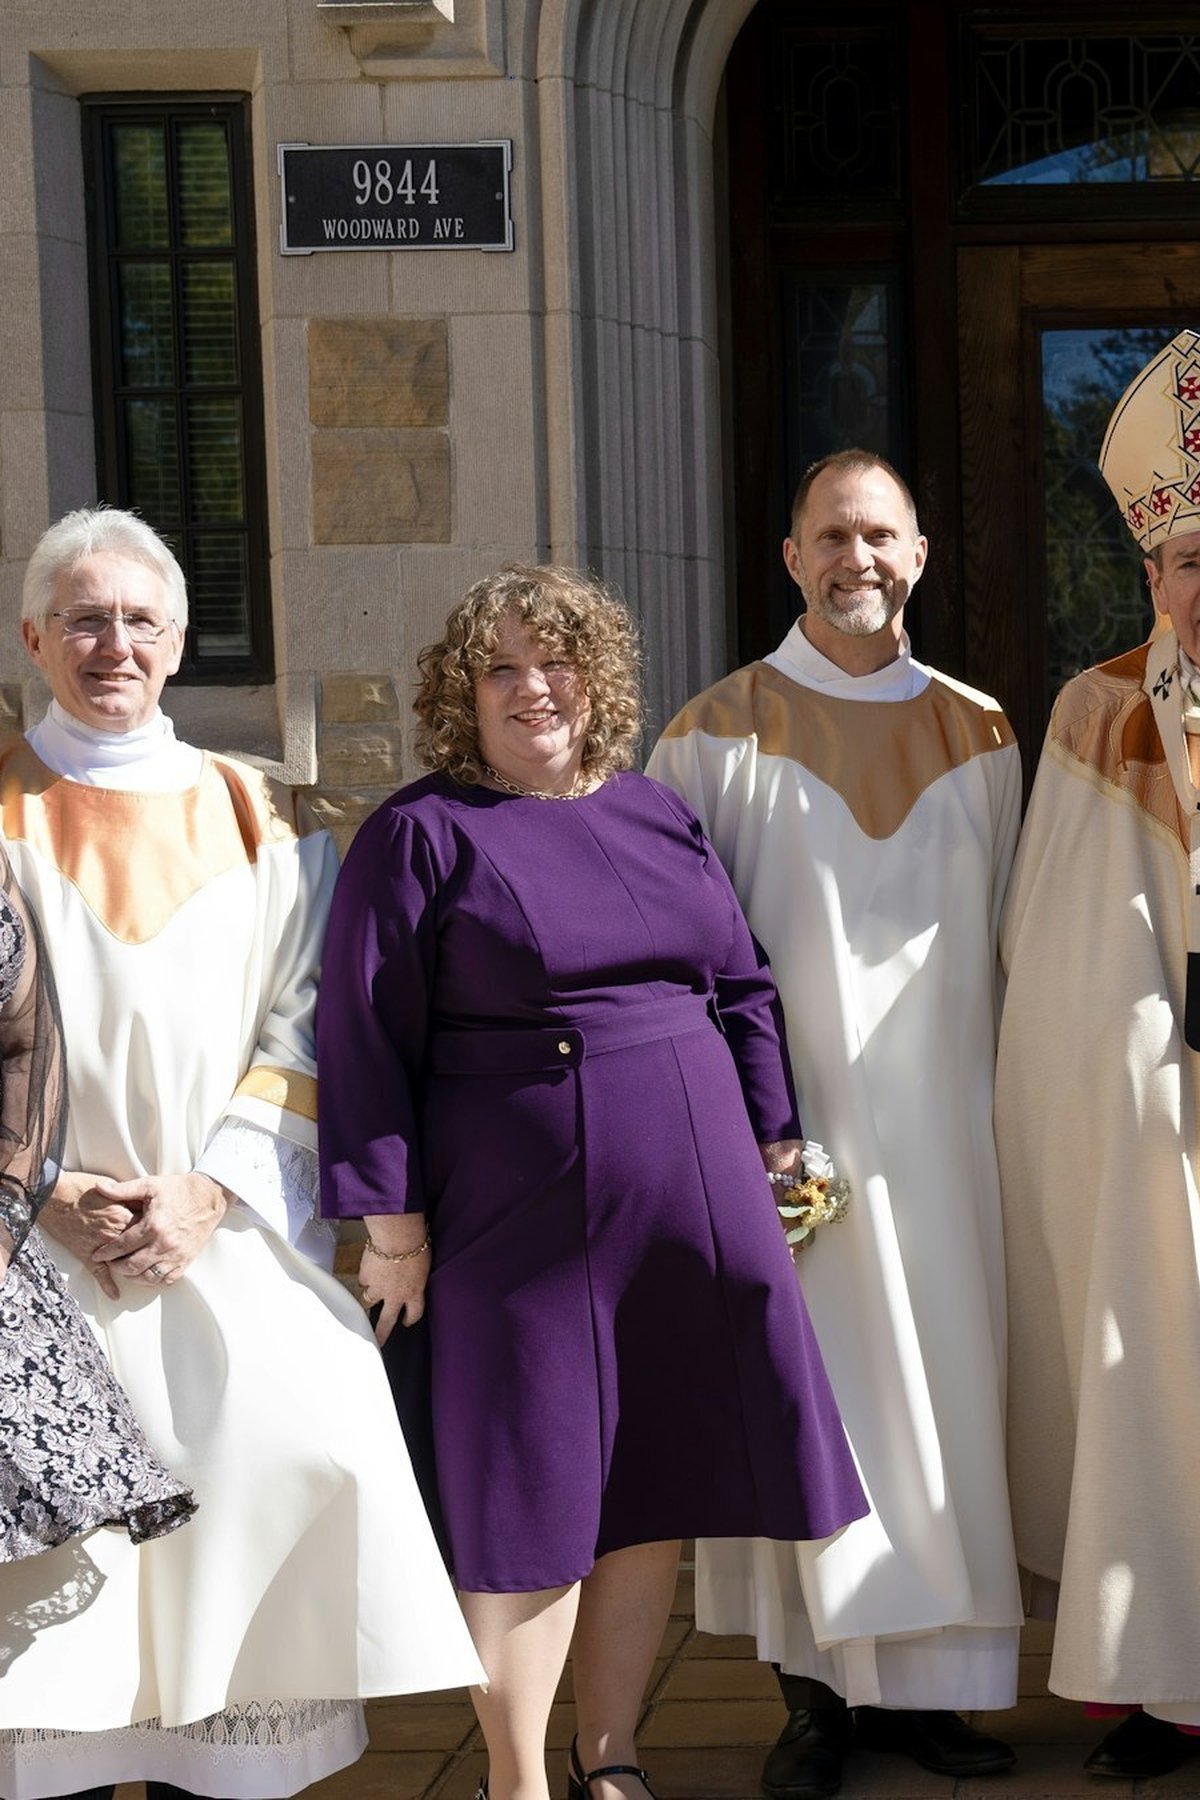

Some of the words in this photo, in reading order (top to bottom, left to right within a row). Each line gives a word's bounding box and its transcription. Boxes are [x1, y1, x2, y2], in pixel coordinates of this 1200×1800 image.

[353, 160, 439, 205] 9844
[322, 218, 419, 240] WOODWARD
[434, 218, 465, 239] AVE
